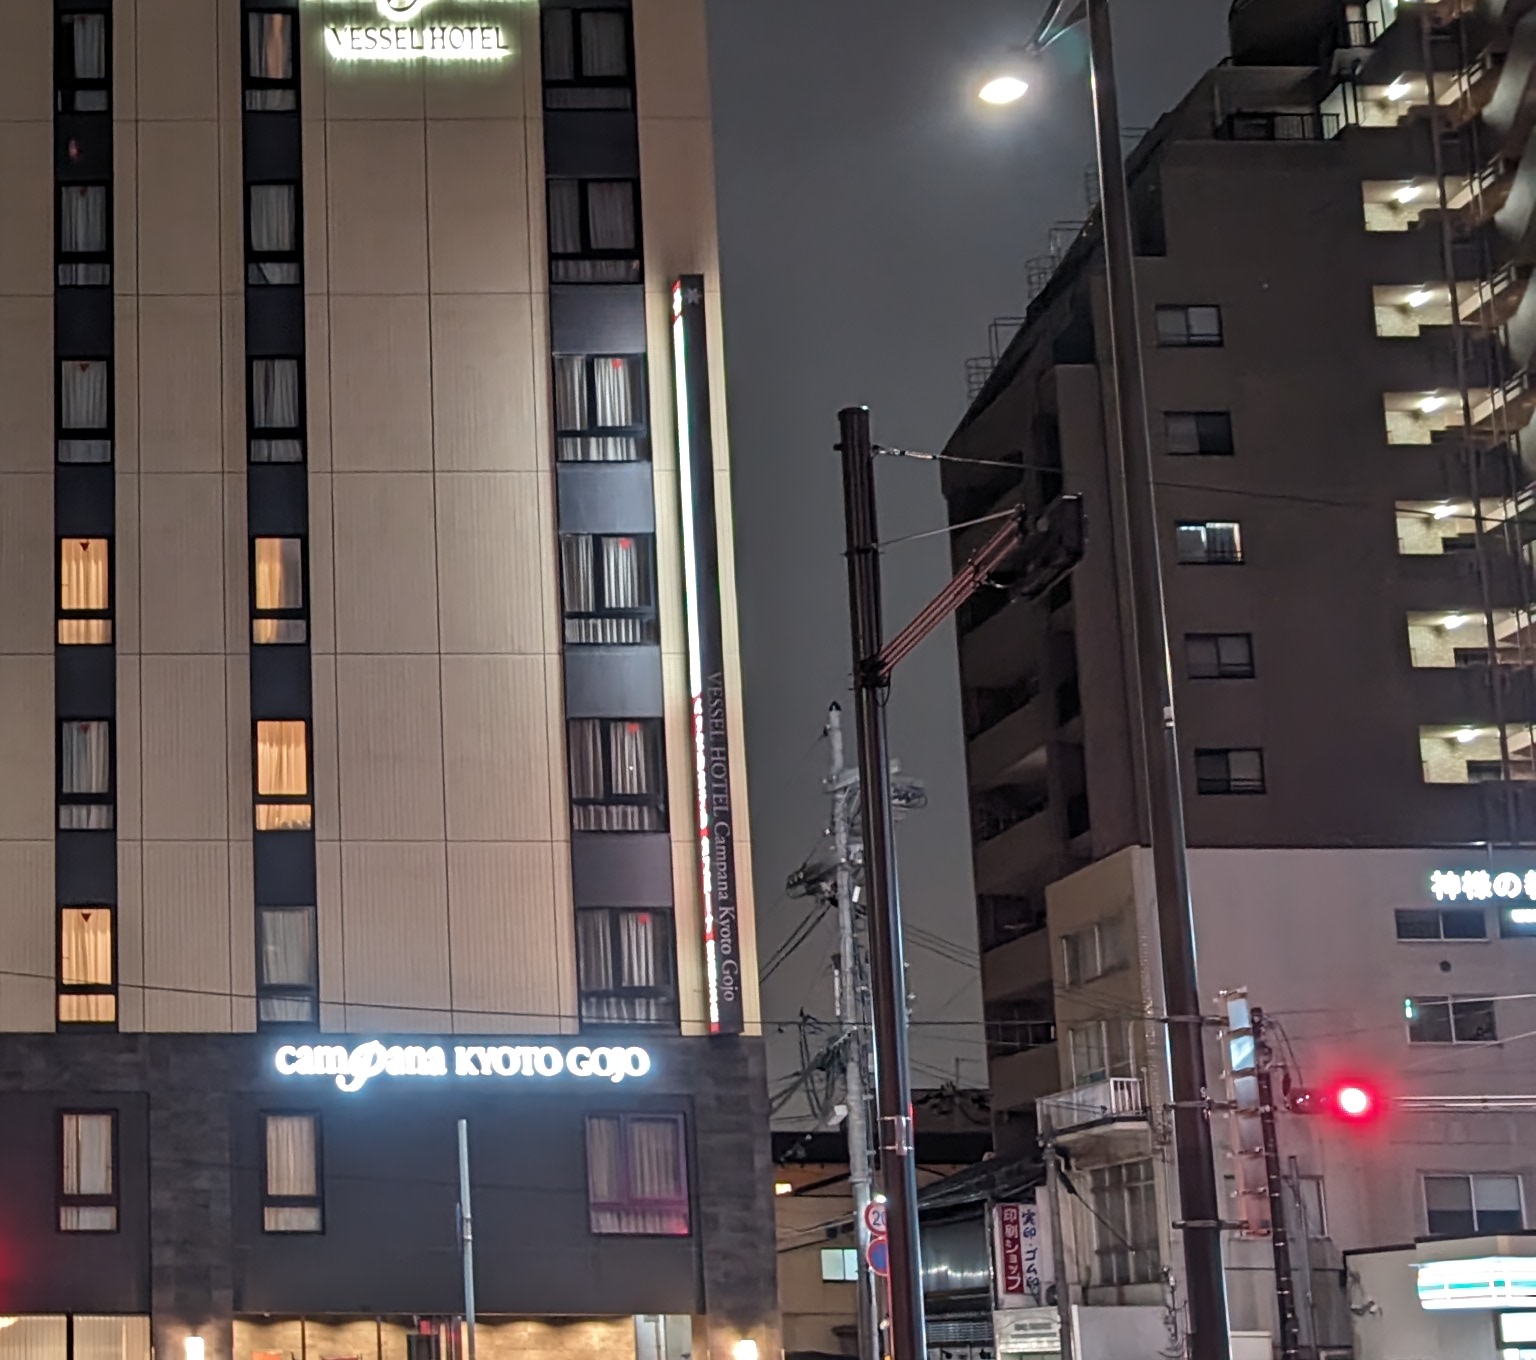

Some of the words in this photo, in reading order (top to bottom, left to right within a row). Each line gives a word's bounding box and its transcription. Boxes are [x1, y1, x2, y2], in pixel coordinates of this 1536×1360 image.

[328, 26, 423, 51] VESSEL
[429, 26, 509, 51] HOTEL
[708, 672, 725, 741] VESSEL
[711, 747, 729, 817] HOTEL
[714, 821, 731, 901] Campana
[718, 906, 736, 955] Kyoto
[722, 959, 739, 1002] Gojo
[275, 1040, 447, 1092] campana
[454, 1046, 563, 1077] KYOTO
[566, 1046, 651, 1083] GOJO
[1003, 1207, 1022, 1291] 印刷ショップ
